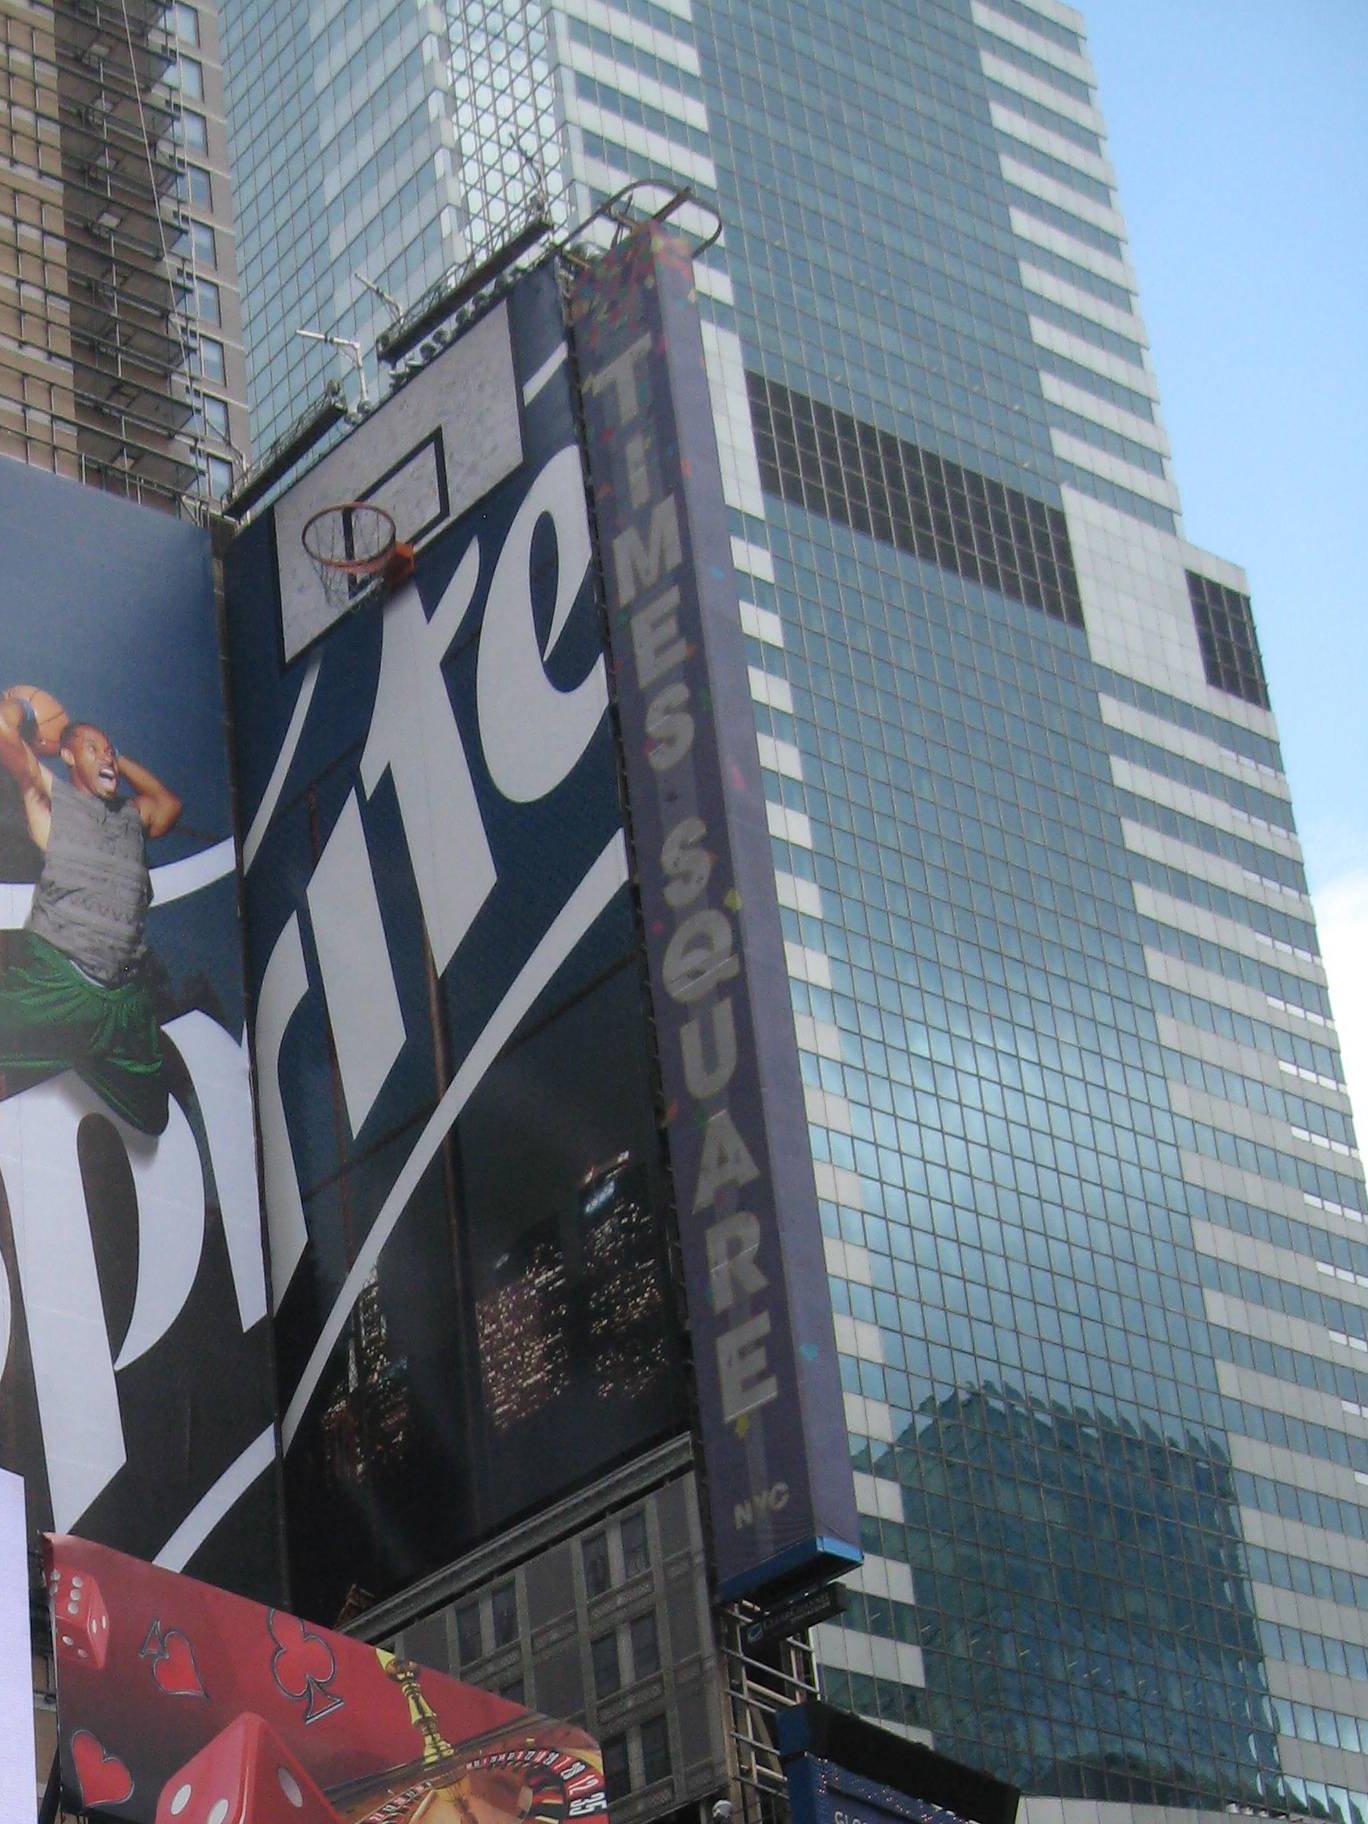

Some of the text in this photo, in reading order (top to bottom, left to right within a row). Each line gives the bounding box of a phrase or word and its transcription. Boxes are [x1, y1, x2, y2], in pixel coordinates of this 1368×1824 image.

[578, 331, 781, 1425] TIMES SQUARE
[734, 1482, 790, 1531] NYC
